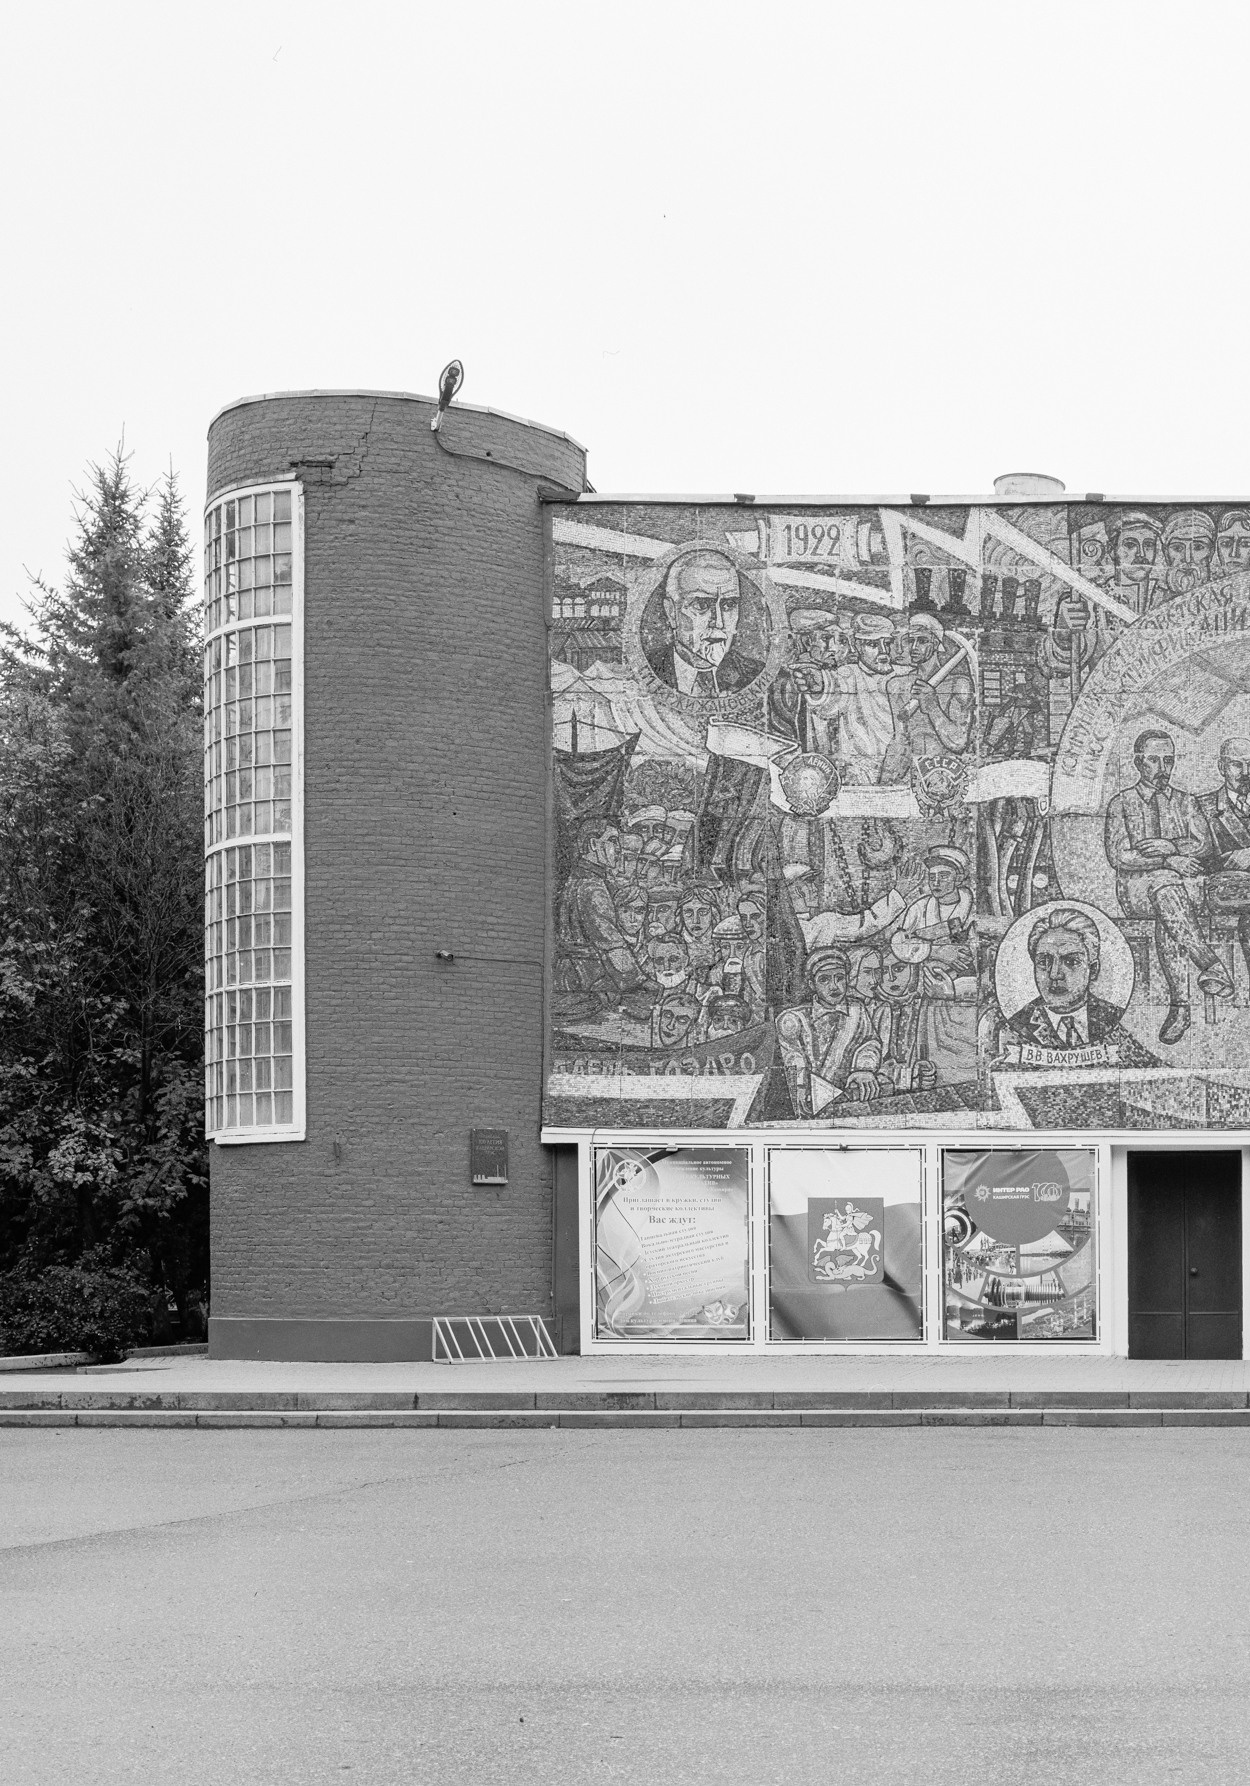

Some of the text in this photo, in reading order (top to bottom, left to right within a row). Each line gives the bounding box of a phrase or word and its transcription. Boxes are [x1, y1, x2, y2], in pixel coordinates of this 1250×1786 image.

[782, 523, 841, 557] 1922
[925, 755, 958, 770] СССР
[1047, 1049, 1103, 1064] ВАХРУШЕВ
[649, 1215, 696, 1226] Вас ждут:
